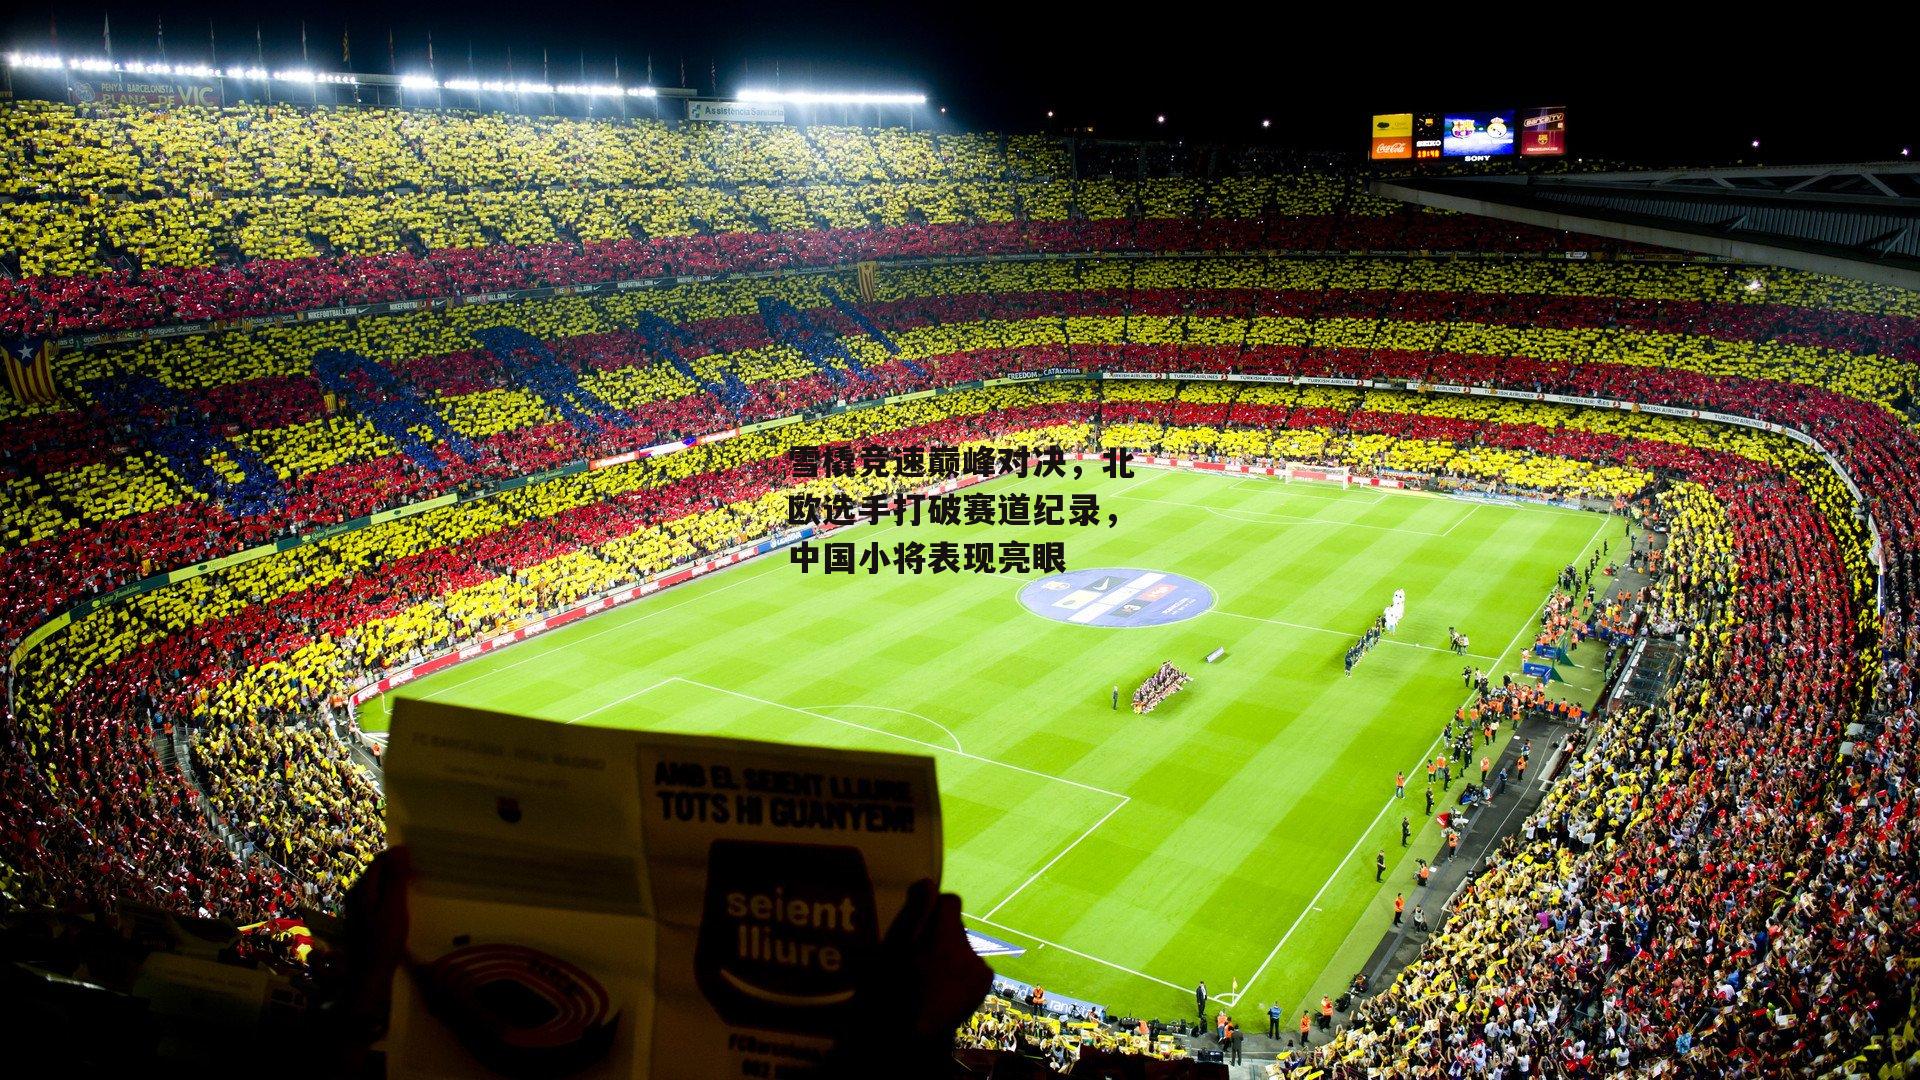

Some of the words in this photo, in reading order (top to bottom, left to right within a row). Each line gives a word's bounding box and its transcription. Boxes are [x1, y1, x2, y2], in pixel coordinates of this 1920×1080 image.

[101, 82, 123, 92] PENYA
[177, 85, 214, 107] VIC
[1007, 371, 1038, 380] FREEDOM
[1043, 367, 1080, 376] CATALONIA
[1662, 407, 1689, 416] AIRLINES
[1714, 414, 1740, 423] TURKISH
[1740, 418, 1763, 428] AIRLINES
[655, 761, 706, 787] AMB
[711, 765, 738, 789] EL
[743, 768, 823, 795] SEIENT
[656, 791, 730, 823] TOTS
[737, 796, 763, 825] HI
[769, 798, 914, 833] GUANYEM!
[725, 884, 857, 932] seient
[737, 924, 843, 973] lliure
